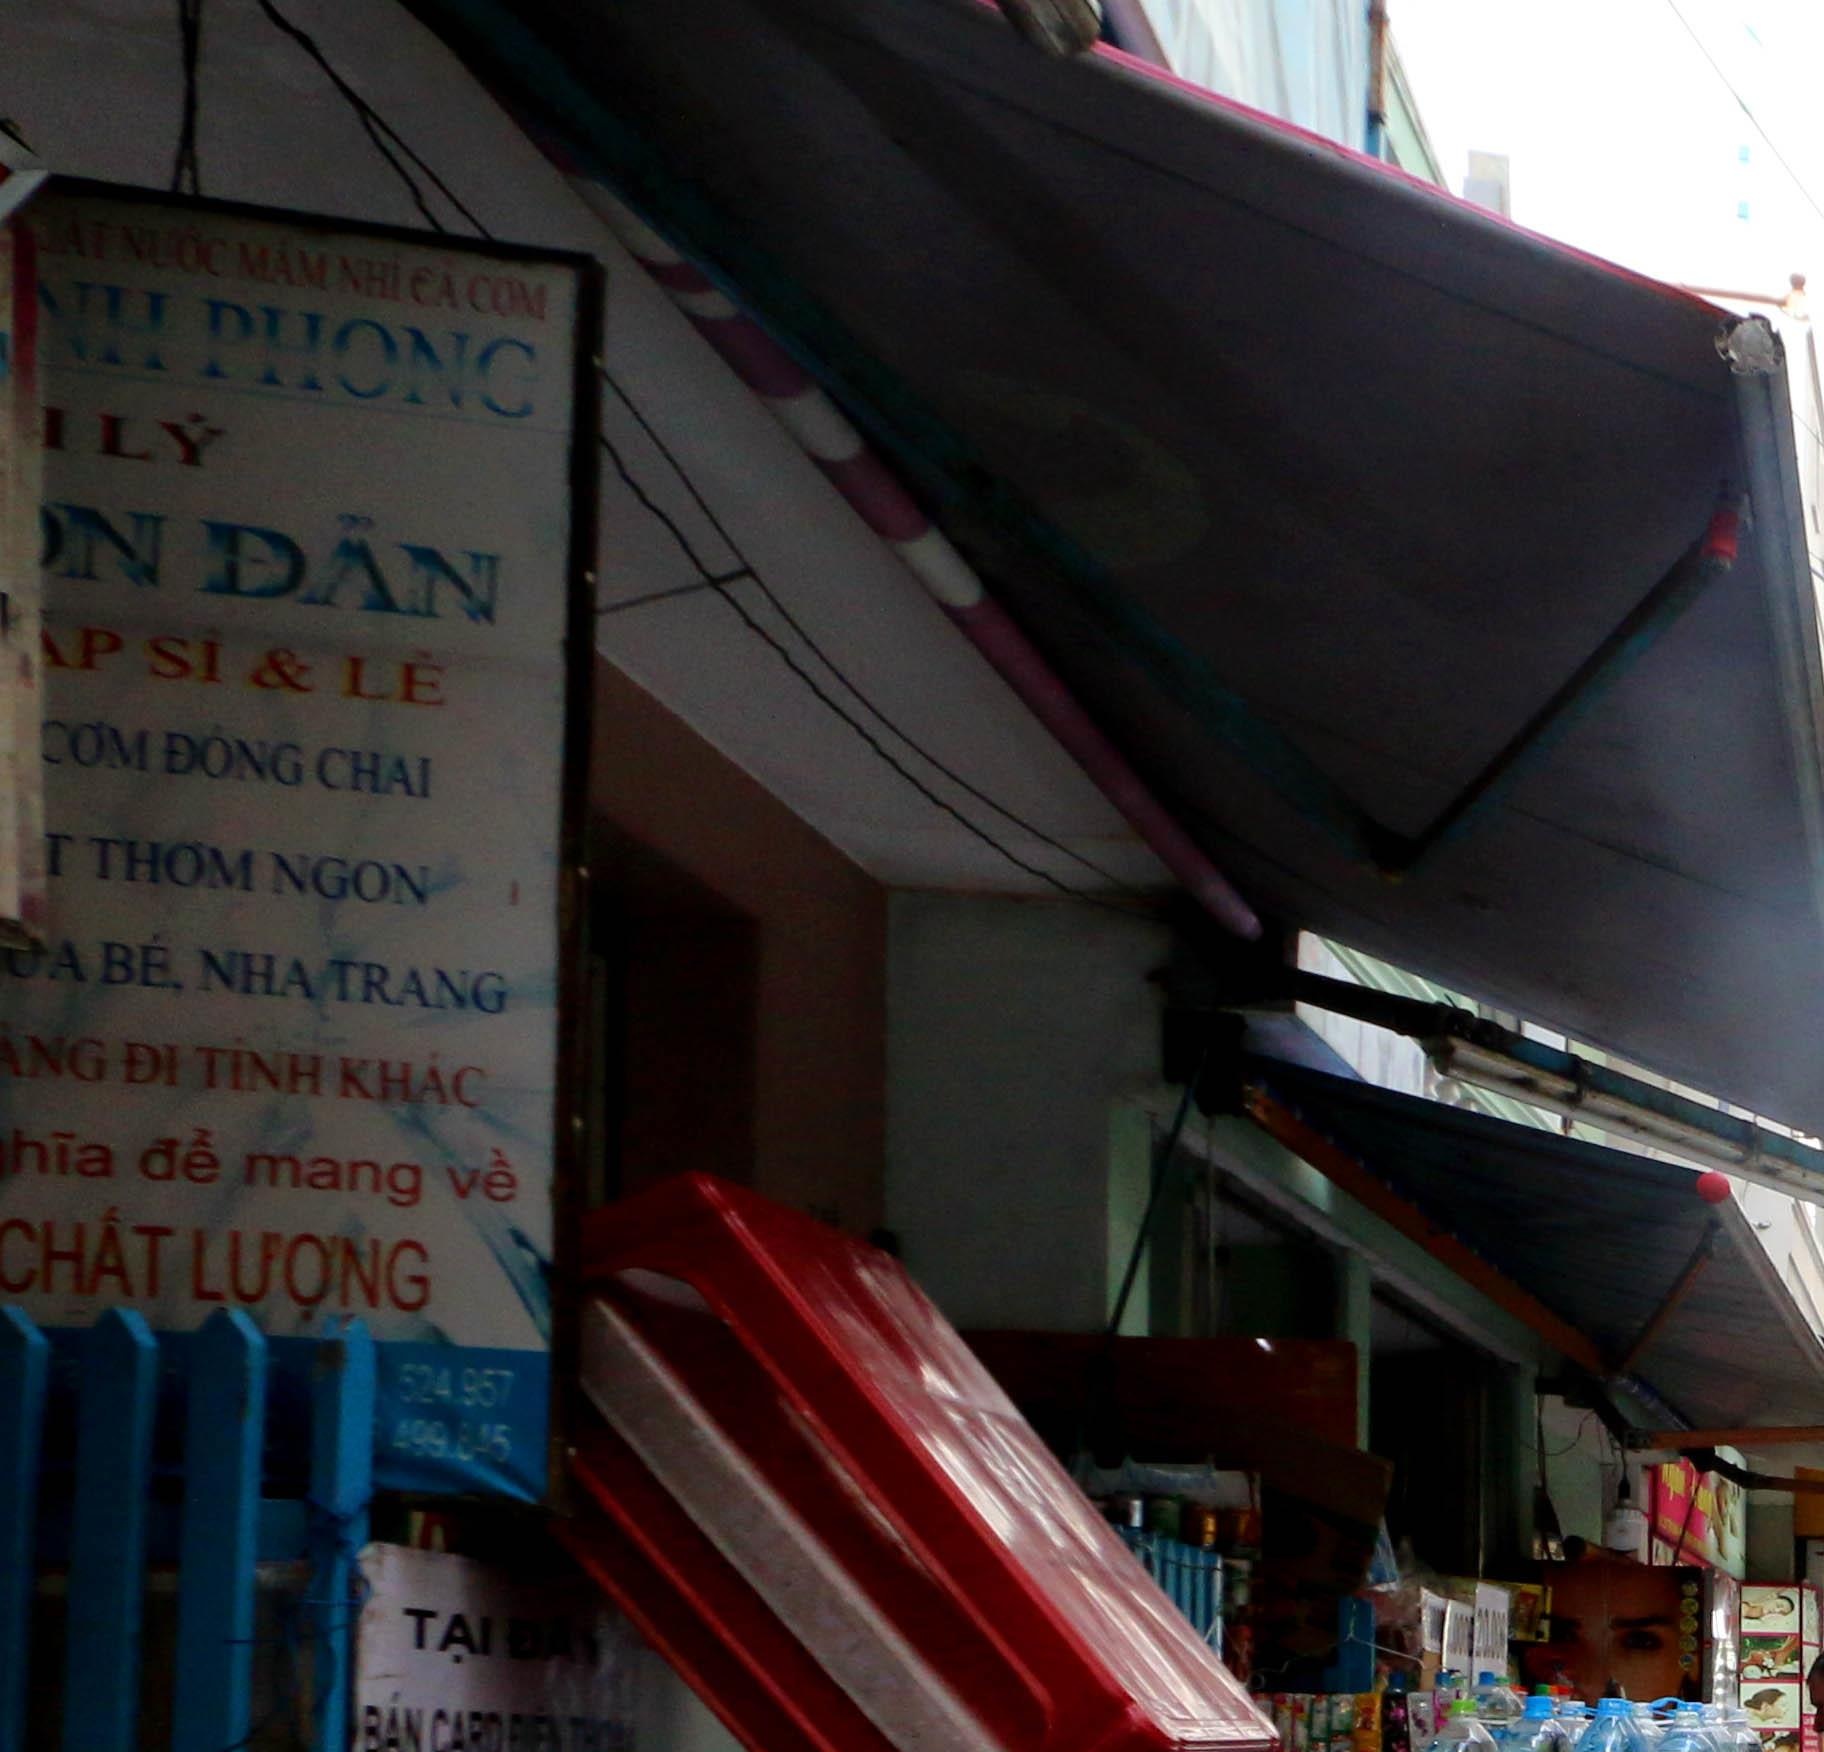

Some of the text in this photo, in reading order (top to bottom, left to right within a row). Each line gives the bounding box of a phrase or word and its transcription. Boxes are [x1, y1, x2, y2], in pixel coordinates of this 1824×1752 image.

[250, 648, 314, 692] &
[317, 744, 432, 799] CHAI
[270, 852, 428, 904] NGON
[199, 949, 507, 1015] NHA TRANG
[246, 1151, 422, 1207] mang
